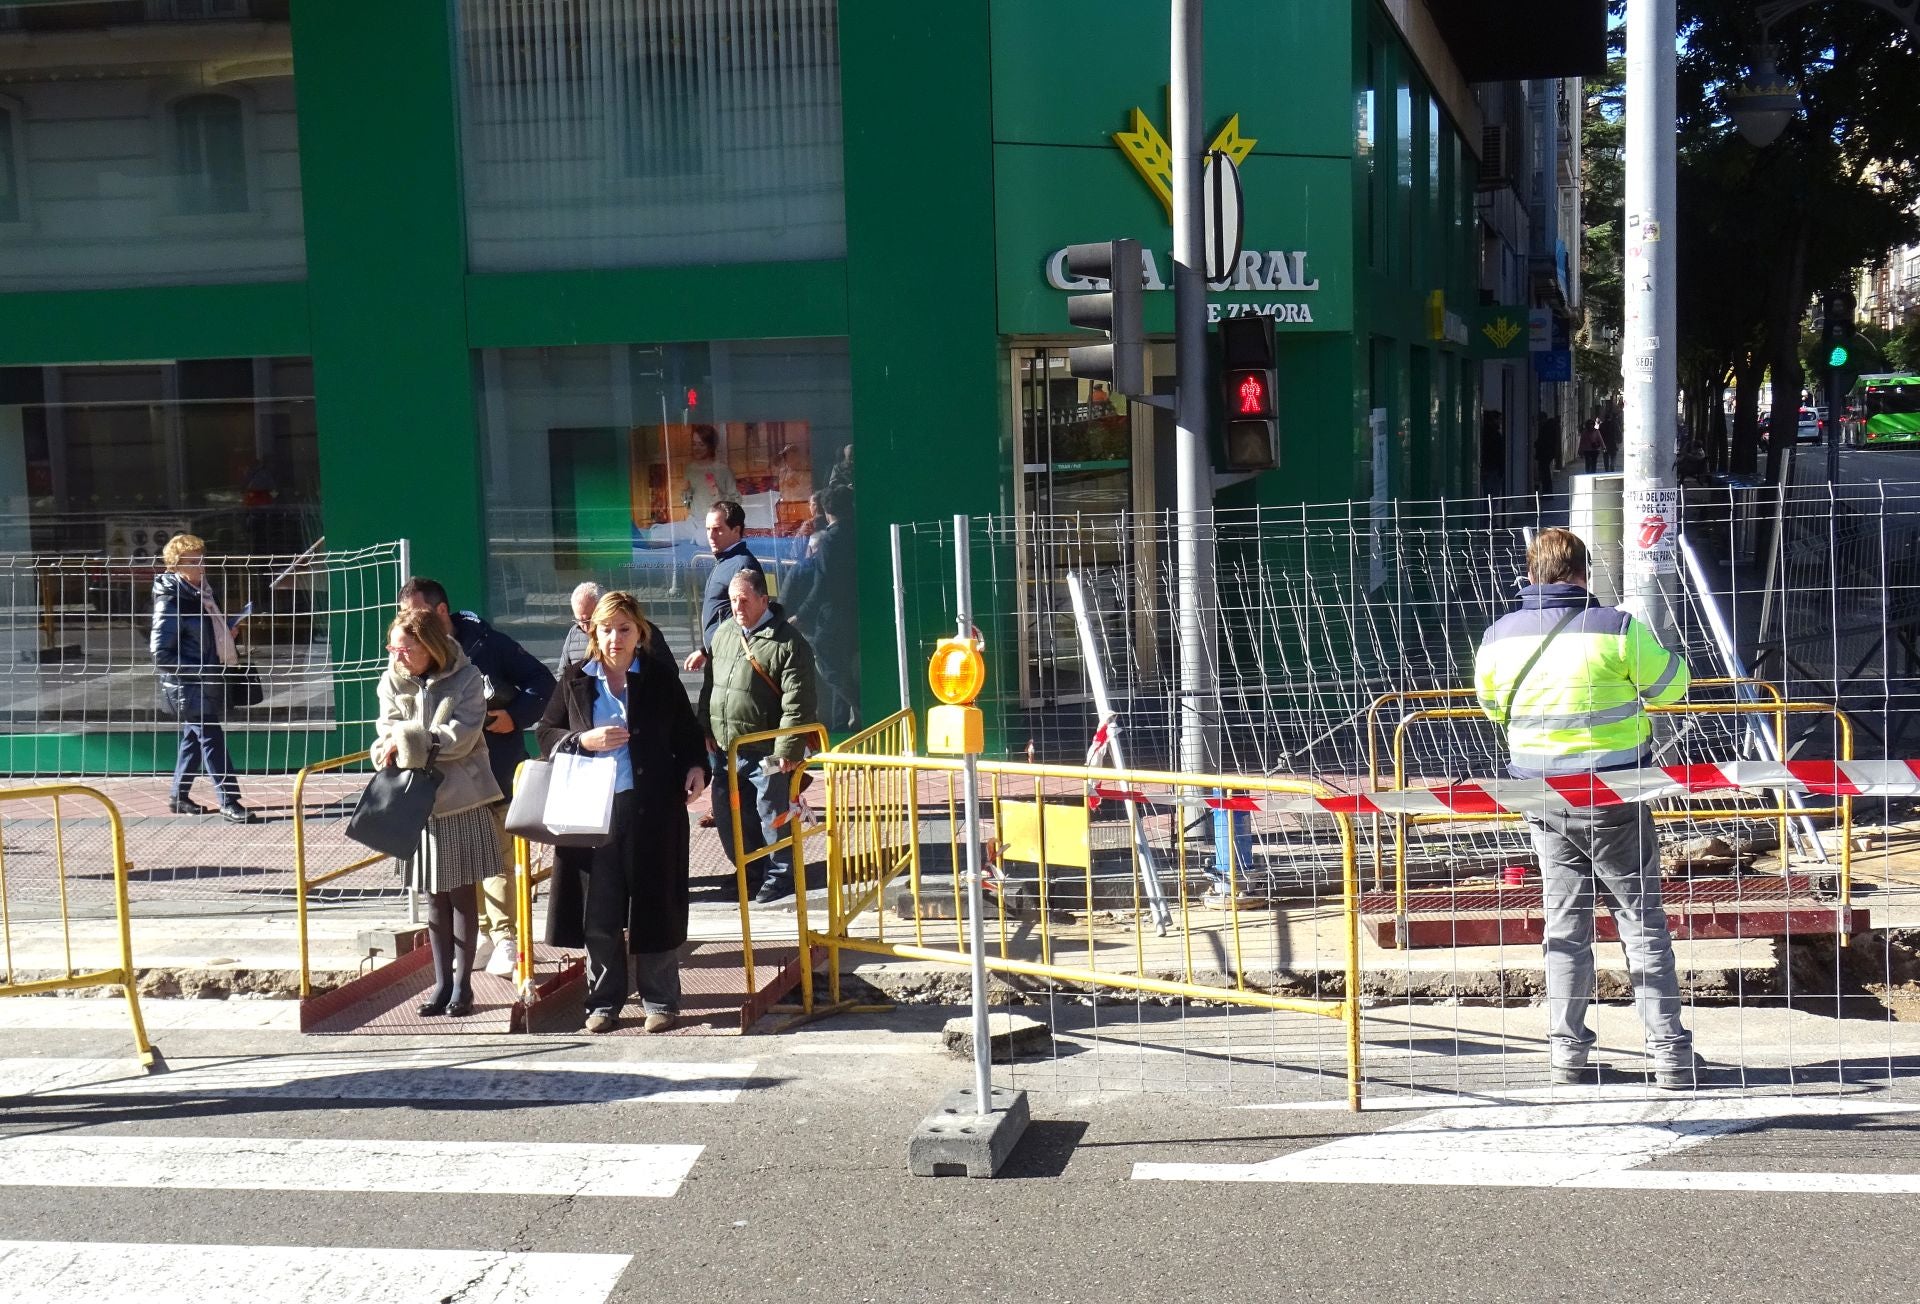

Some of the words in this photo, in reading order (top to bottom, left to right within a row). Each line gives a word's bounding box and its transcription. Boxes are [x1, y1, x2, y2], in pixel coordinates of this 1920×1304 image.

[1206, 303, 1221, 323] E
[1645, 491, 1659, 503] DEL
[1660, 491, 1676, 503] DISCO
[1642, 503, 1654, 513] DEL
